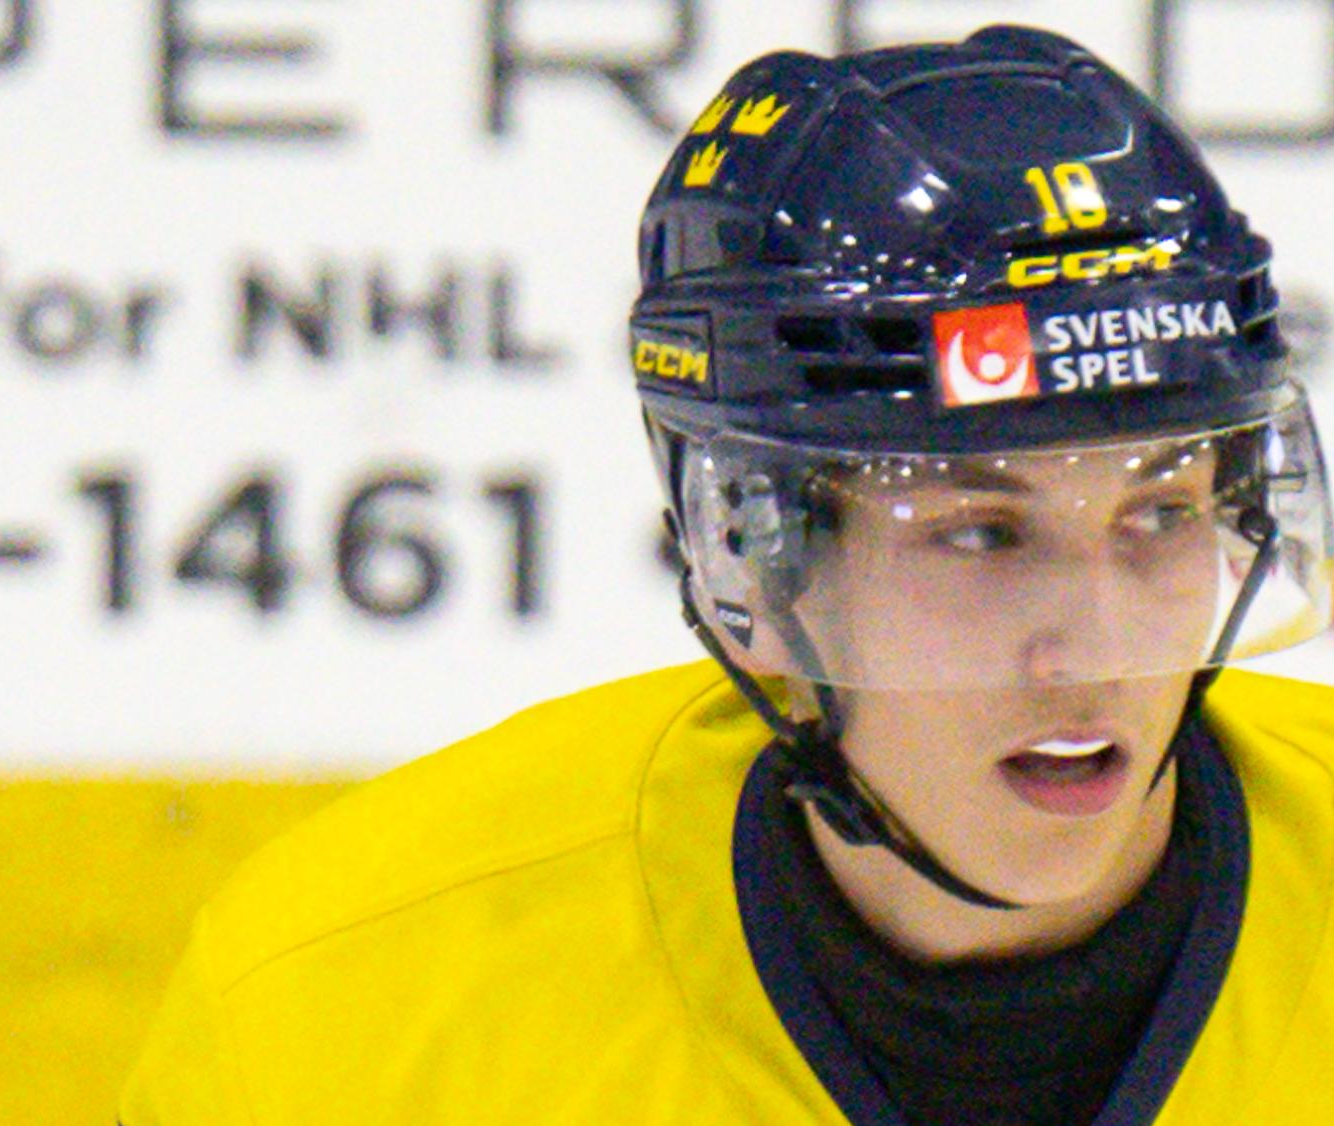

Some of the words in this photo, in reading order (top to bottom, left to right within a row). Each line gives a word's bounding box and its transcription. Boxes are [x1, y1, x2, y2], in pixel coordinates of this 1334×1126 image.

[1024, 162, 1108, 235] 18
[1007, 245, 1175, 288] CCM
[233, 258, 557, 372] NHL
[1043, 300, 1238, 353] SVENSKA
[635, 340, 710, 382] CCM
[1051, 348, 1160, 394] SPEL
